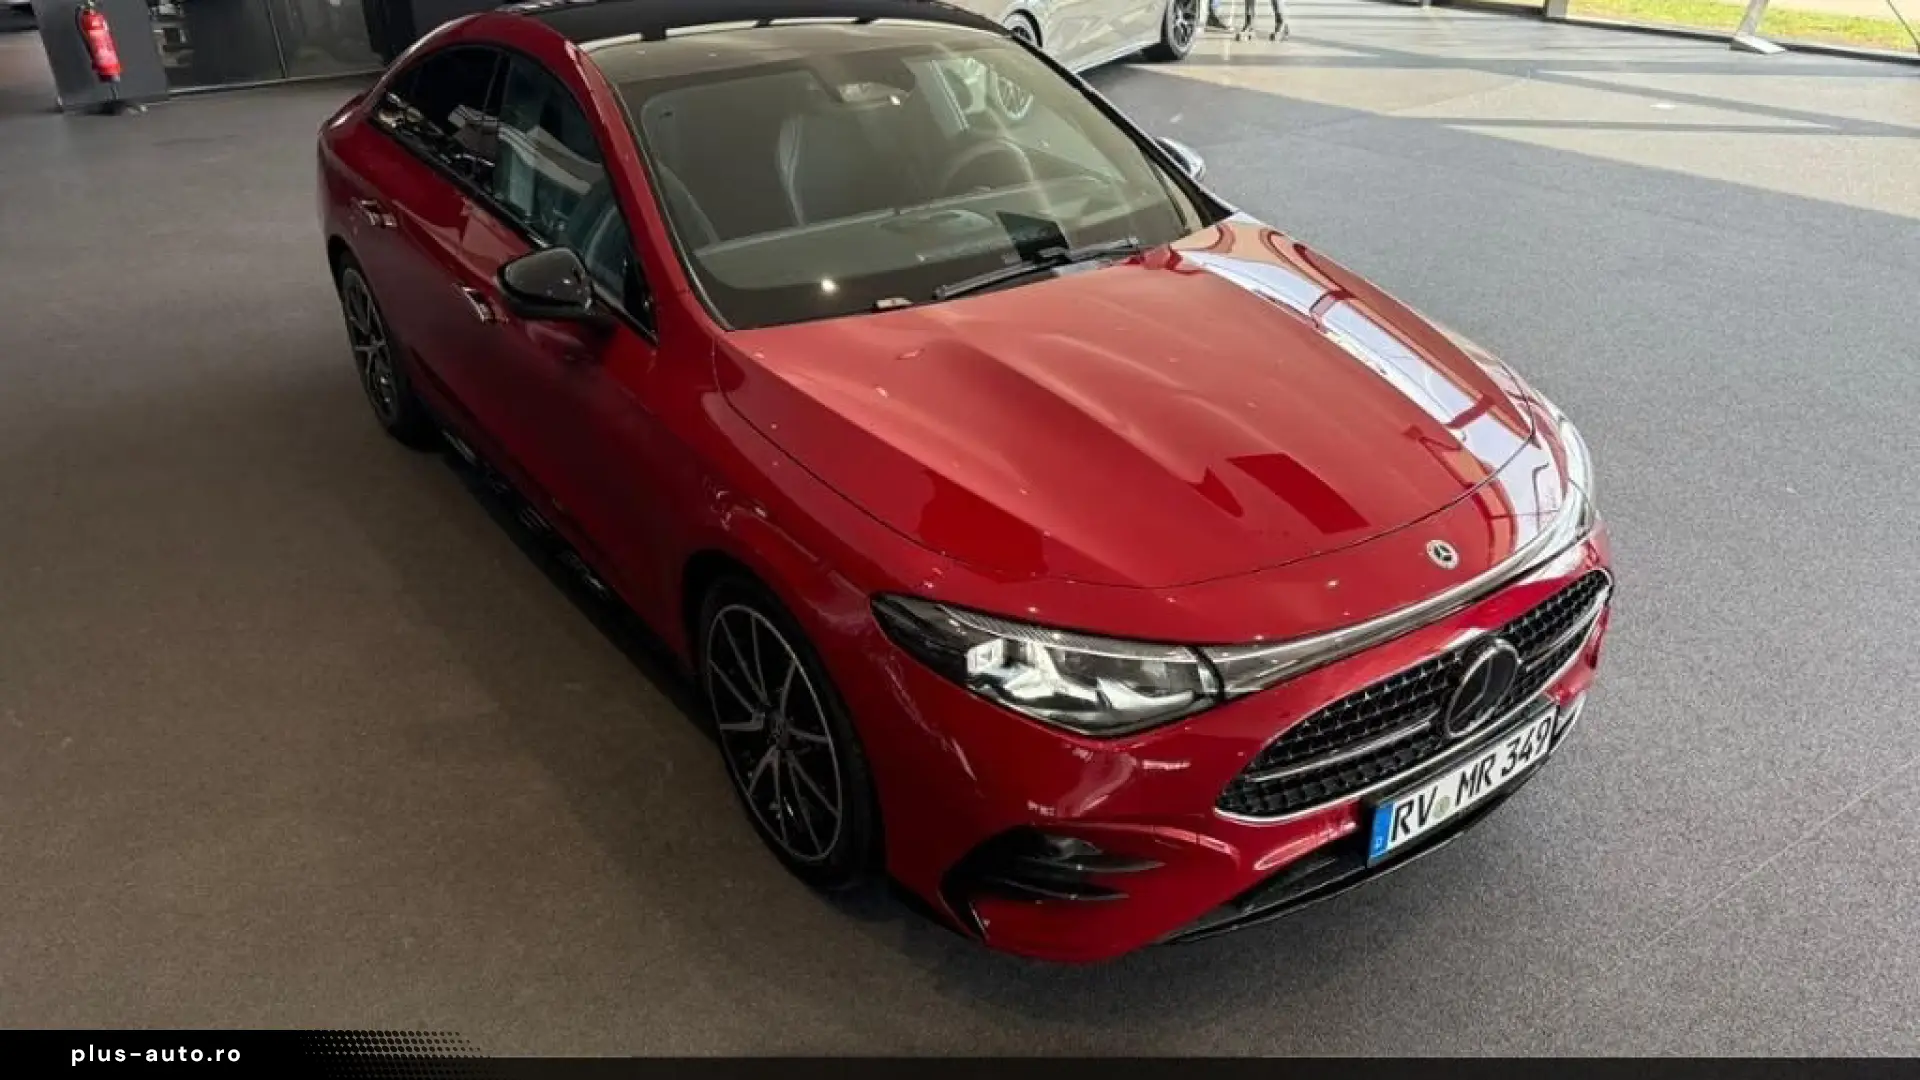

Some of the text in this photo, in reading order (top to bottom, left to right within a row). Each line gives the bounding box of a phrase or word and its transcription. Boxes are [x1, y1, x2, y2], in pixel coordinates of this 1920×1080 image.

[1391, 716, 1552, 842] RV MR 349
